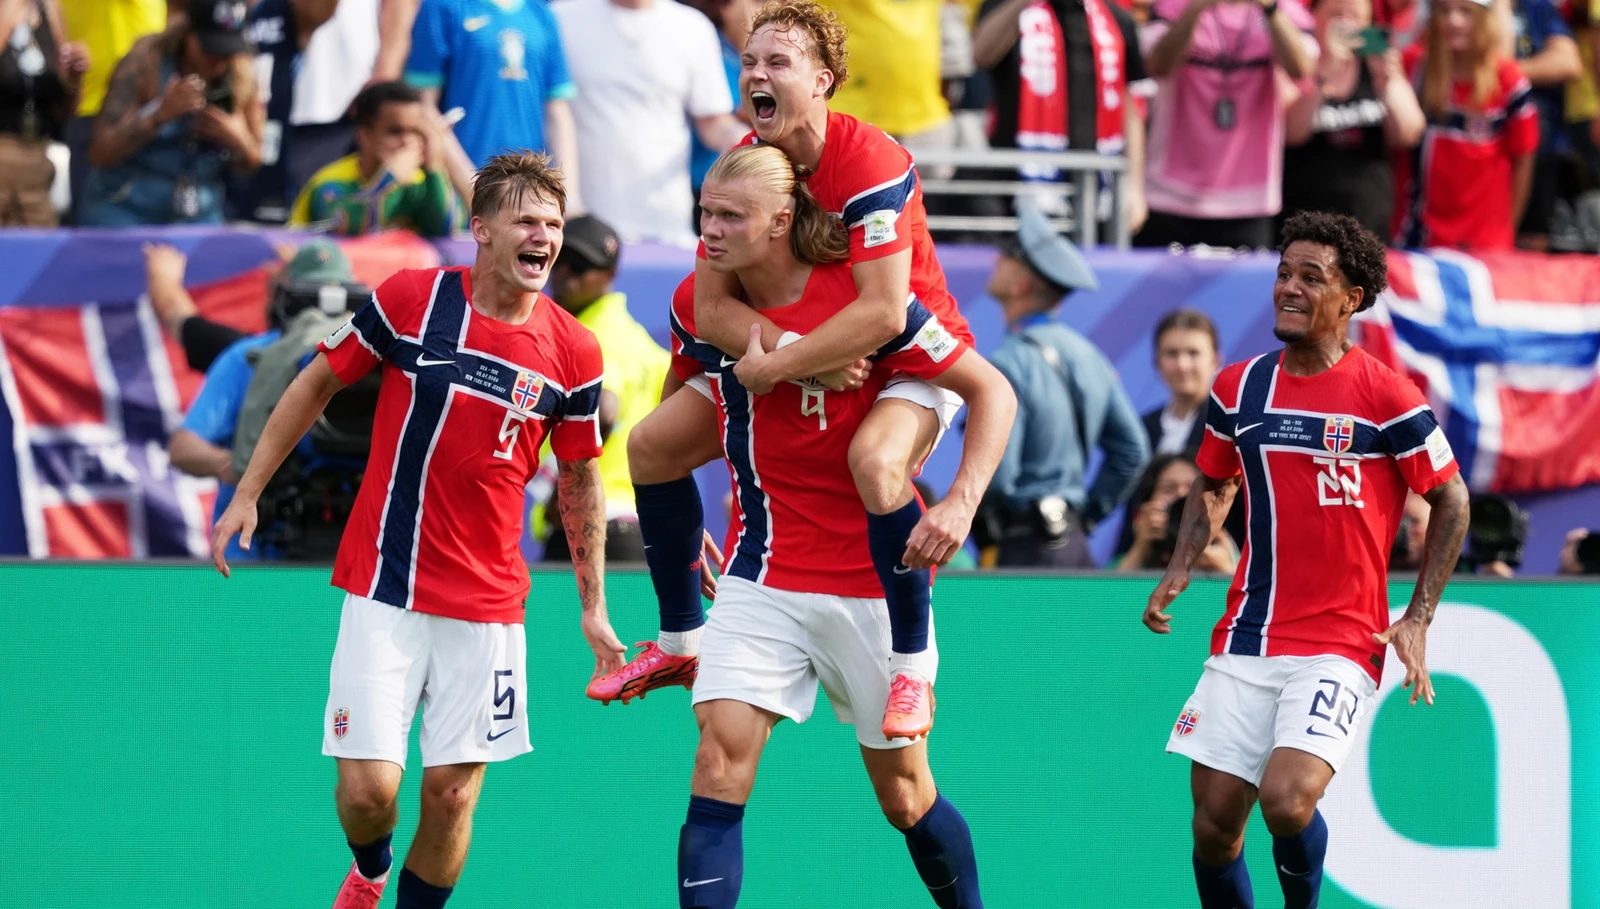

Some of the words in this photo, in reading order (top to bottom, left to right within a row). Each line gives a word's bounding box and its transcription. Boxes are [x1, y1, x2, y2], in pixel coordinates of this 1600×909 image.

[474, 378, 483, 386] YORK
[492, 384, 506, 393] JERSEY
[801, 387, 827, 431] 9
[492, 409, 528, 460] 5
[1313, 456, 1364, 508] 22
[493, 669, 515, 720] 5
[1308, 678, 1358, 736] 22
